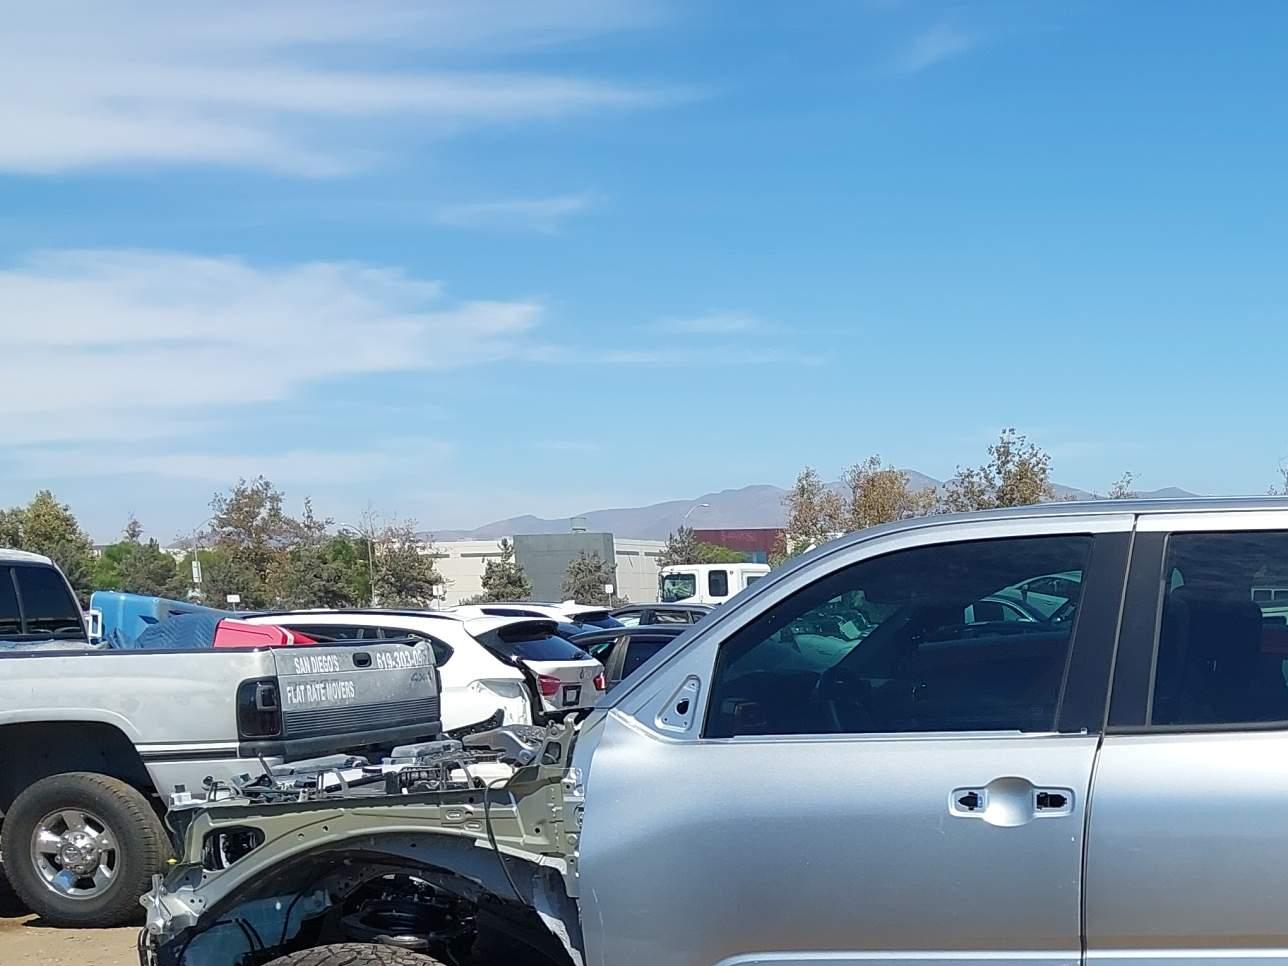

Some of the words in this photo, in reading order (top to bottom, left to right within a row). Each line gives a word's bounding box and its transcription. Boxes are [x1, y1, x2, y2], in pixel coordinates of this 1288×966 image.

[294, 657, 311, 674] SAN
[311, 654, 340, 673] DIEGO'S
[286, 685, 305, 704] FLAT
[306, 683, 326, 702] RATE
[326, 680, 355, 701] MOVERS
